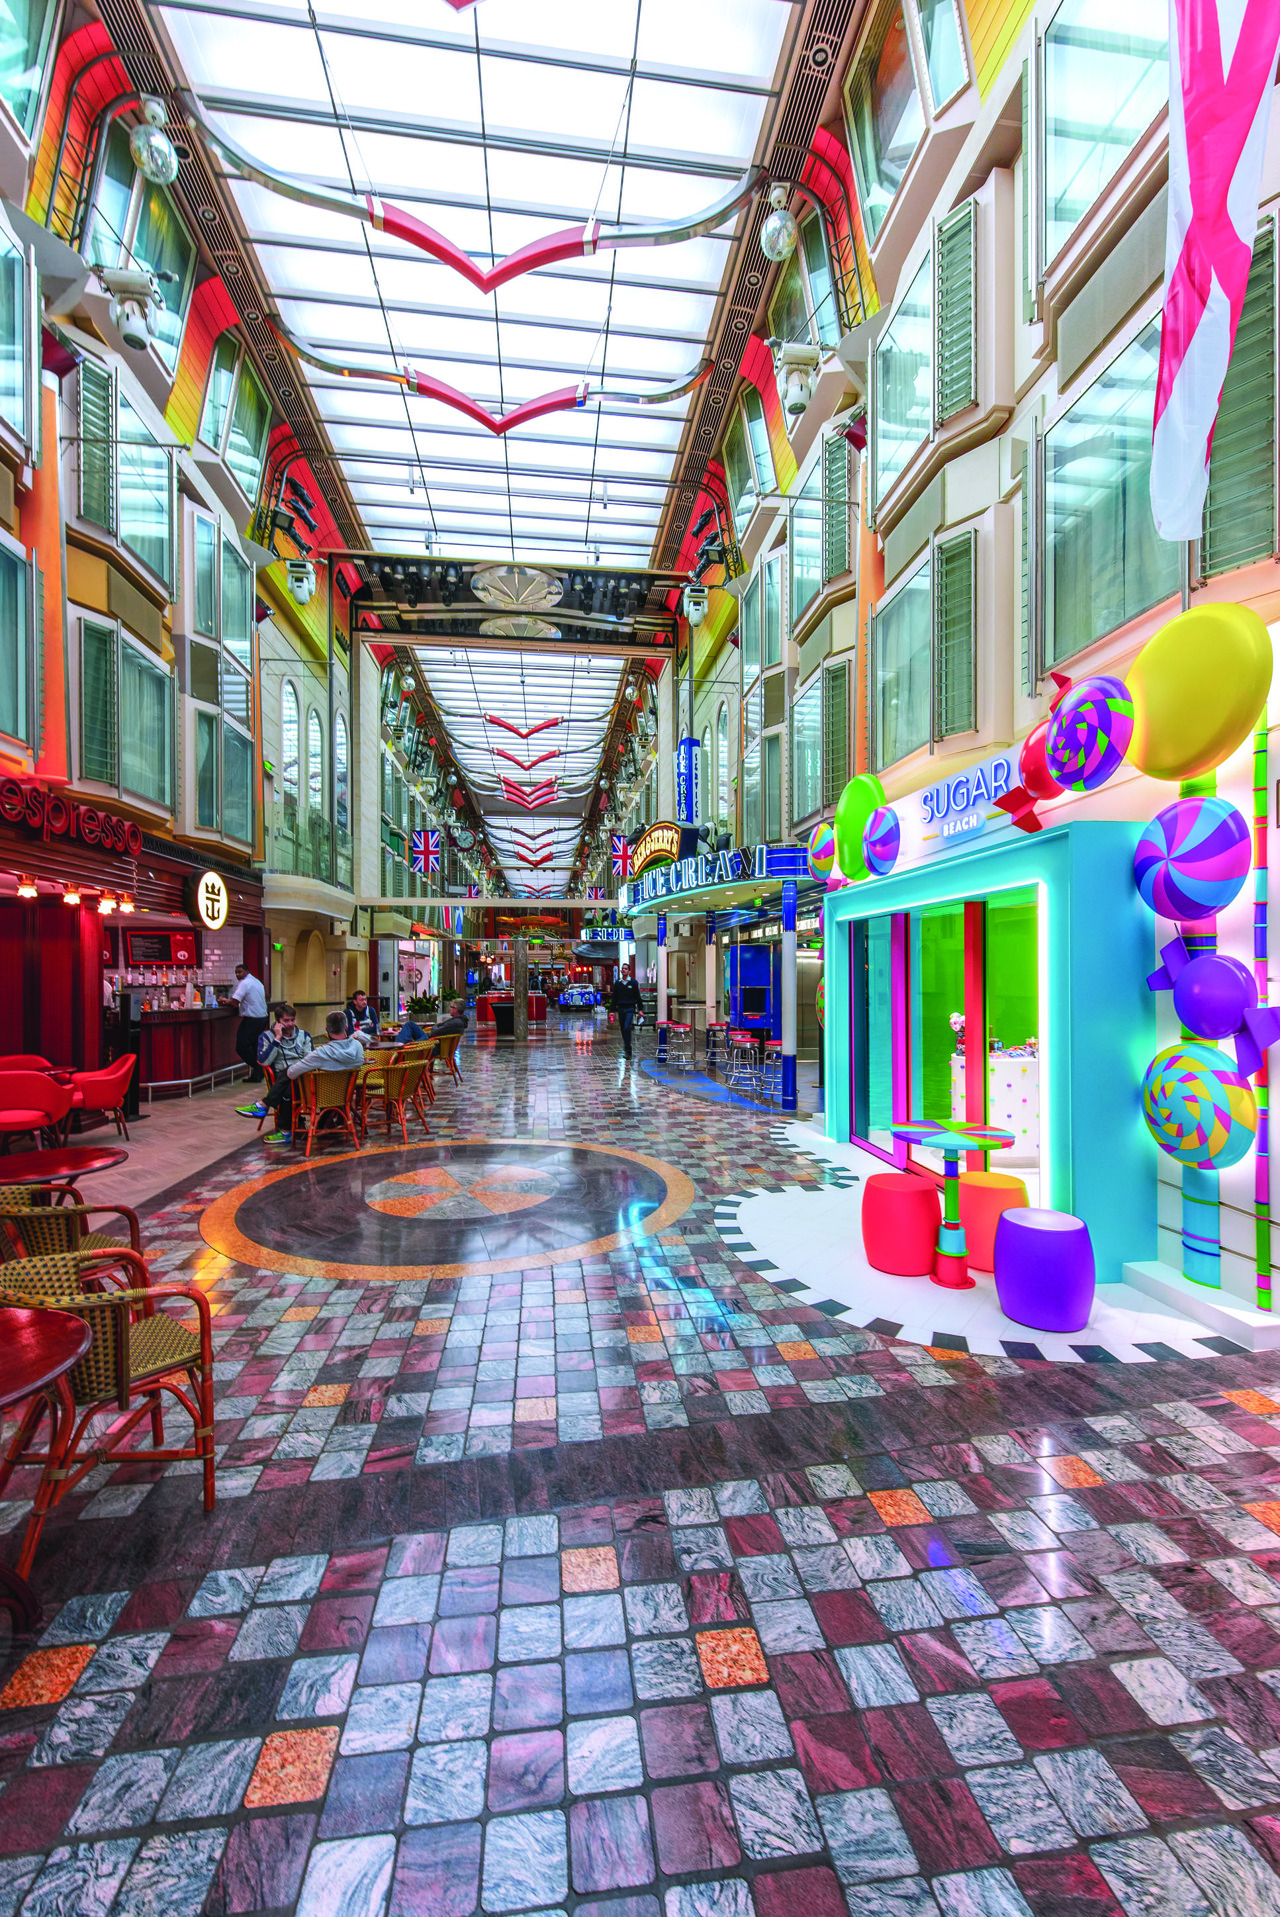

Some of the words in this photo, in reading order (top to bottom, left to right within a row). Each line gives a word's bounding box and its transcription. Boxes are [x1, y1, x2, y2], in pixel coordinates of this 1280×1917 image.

[679, 745, 688, 773] ICE
[679, 775, 688, 821] CREAM
[921, 758, 1011, 824] SUGAR
[0, 778, 143, 856] espresso
[943, 814, 978, 837] BEACH
[643, 867, 667, 899] ICE
[669, 844, 768, 893] CREAM
